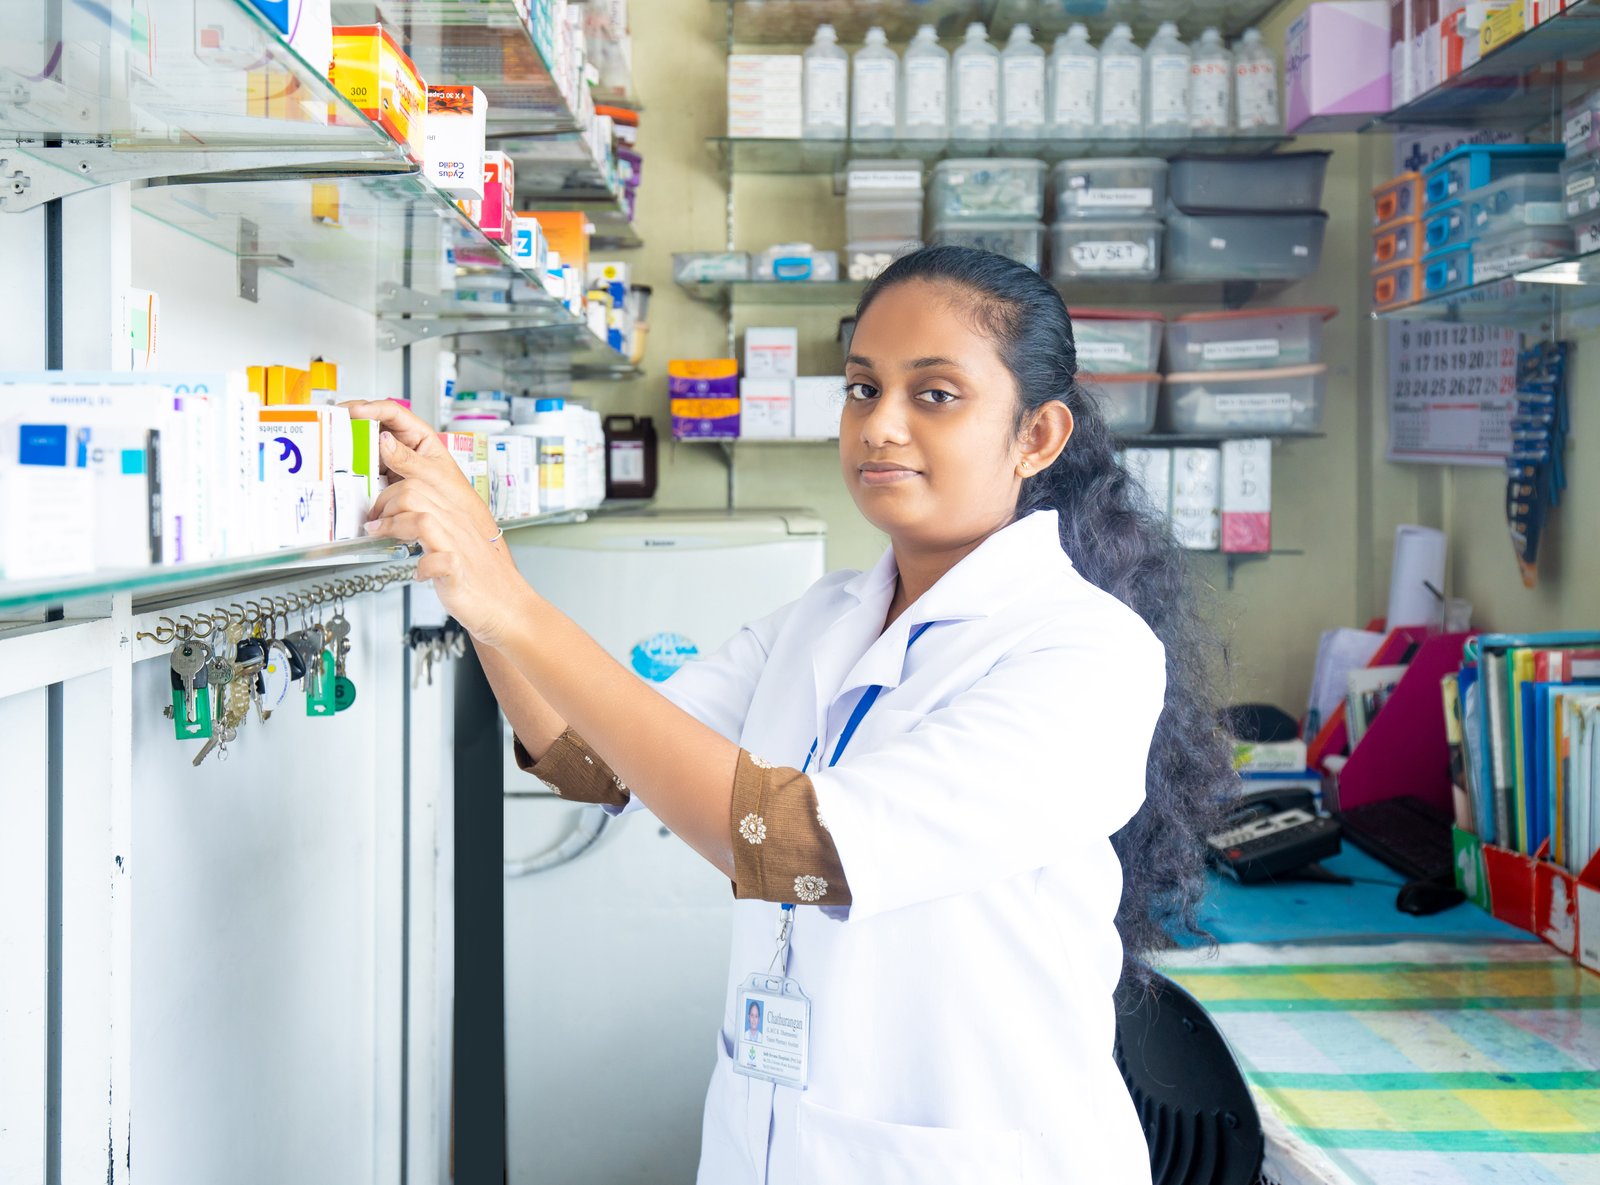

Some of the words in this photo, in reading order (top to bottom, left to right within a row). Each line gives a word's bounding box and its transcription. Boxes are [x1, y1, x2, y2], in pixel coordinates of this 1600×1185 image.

[350, 87, 367, 96] 300
[438, 161, 465, 170] Cadila
[438, 169, 465, 179] Zydus
[1402, 331, 1410, 349] 9
[1417, 330, 1431, 348] 10
[1435, 328, 1448, 346] 11
[1452, 327, 1467, 345] 12
[1471, 326, 1484, 343] 13
[1416, 353, 1430, 372] 17
[1434, 352, 1448, 371] 18
[1451, 352, 1467, 370] 19
[1469, 350, 1484, 369] 20
[1486, 350, 1498, 368] 21
[1502, 347, 1514, 368] 22
[1396, 379, 1410, 397] 23
[1413, 379, 1427, 397] 24
[1431, 378, 1446, 396] 25
[1450, 378, 1465, 396] 26
[1468, 377, 1482, 395] 27
[1485, 378, 1497, 395] 28
[1500, 374, 1514, 396] 29
[259, 425, 288, 434] Tablets
[290, 425, 304, 434] 300
